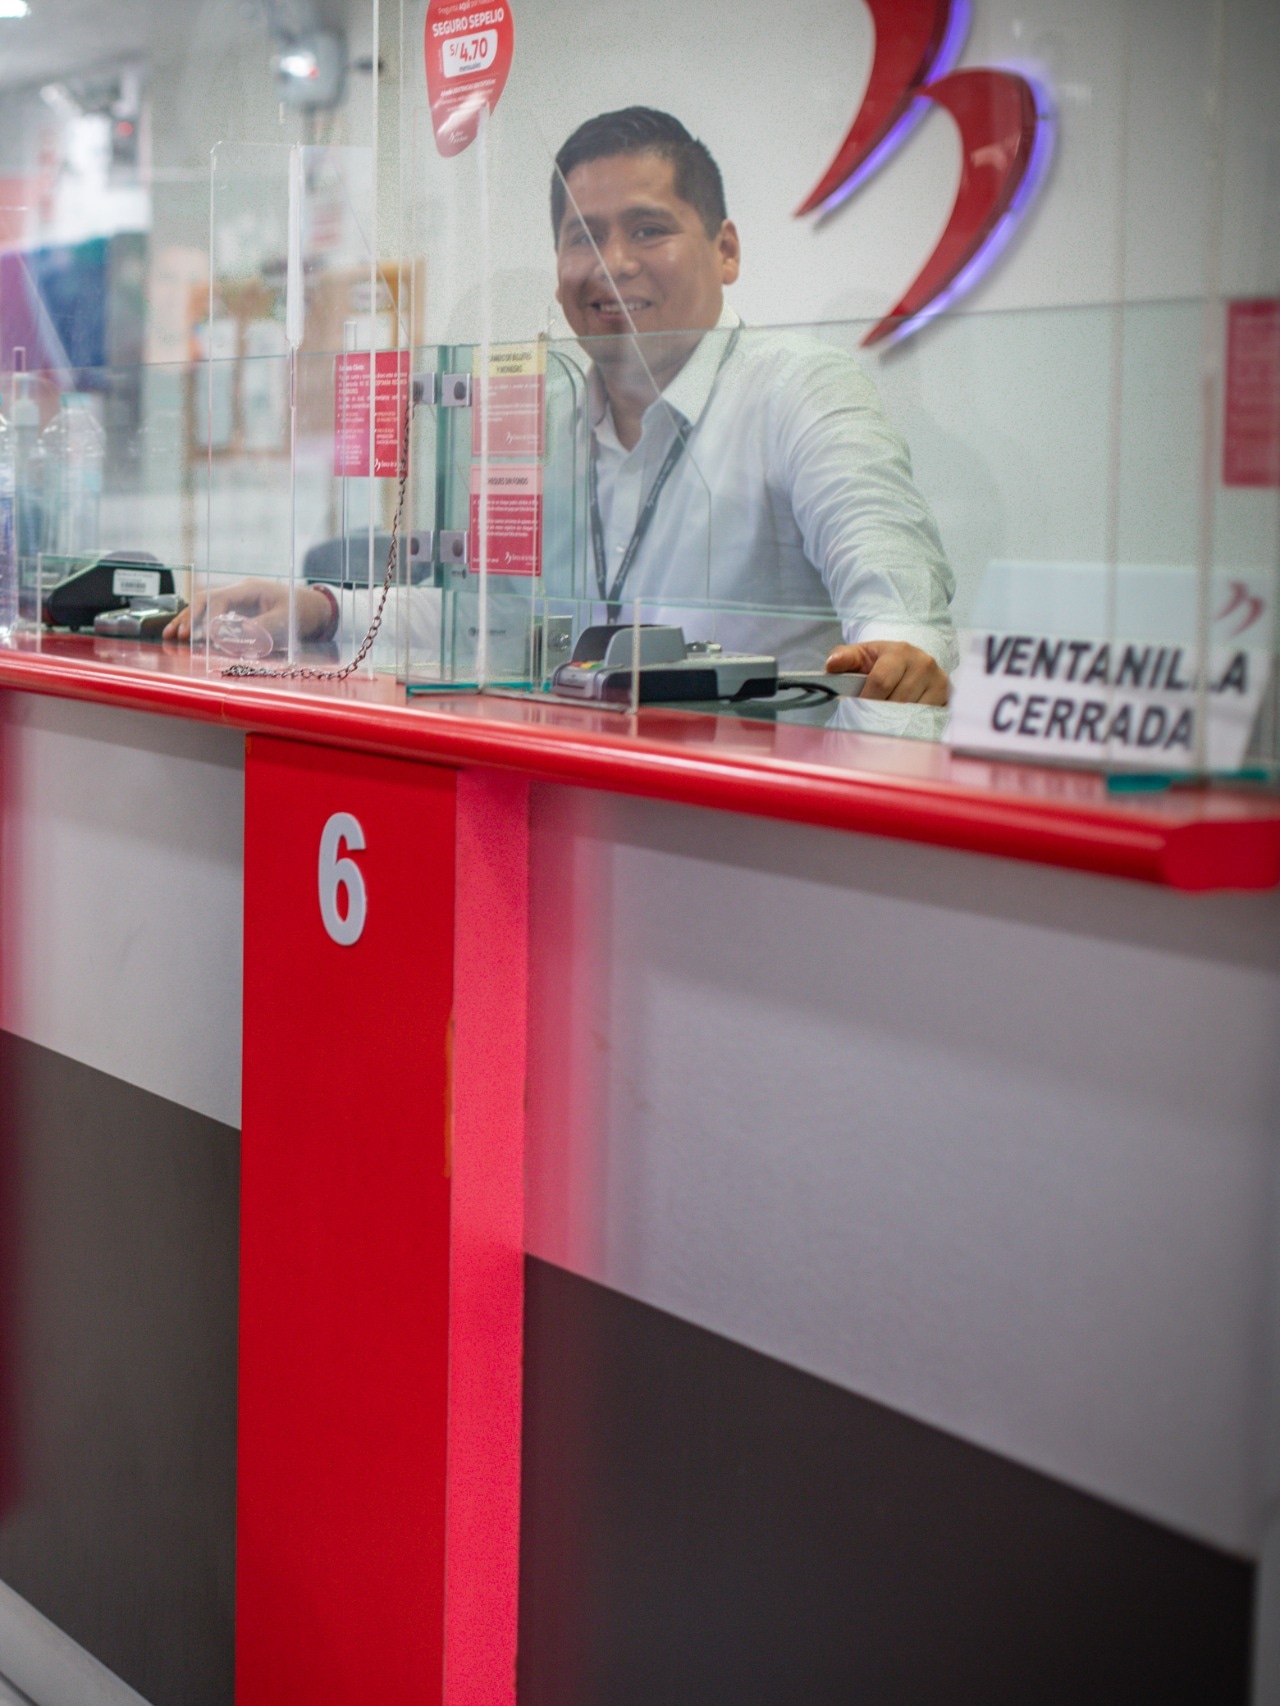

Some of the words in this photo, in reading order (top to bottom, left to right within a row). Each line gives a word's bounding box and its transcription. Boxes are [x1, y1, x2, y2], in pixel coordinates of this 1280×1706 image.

[432, 16, 468, 37] SEGURO
[469, 7, 504, 29] SEPELIO
[983, 634, 1249, 695] VENTANILA
[990, 692, 1195, 750] CERRADA
[318, 812, 367, 946] 6
